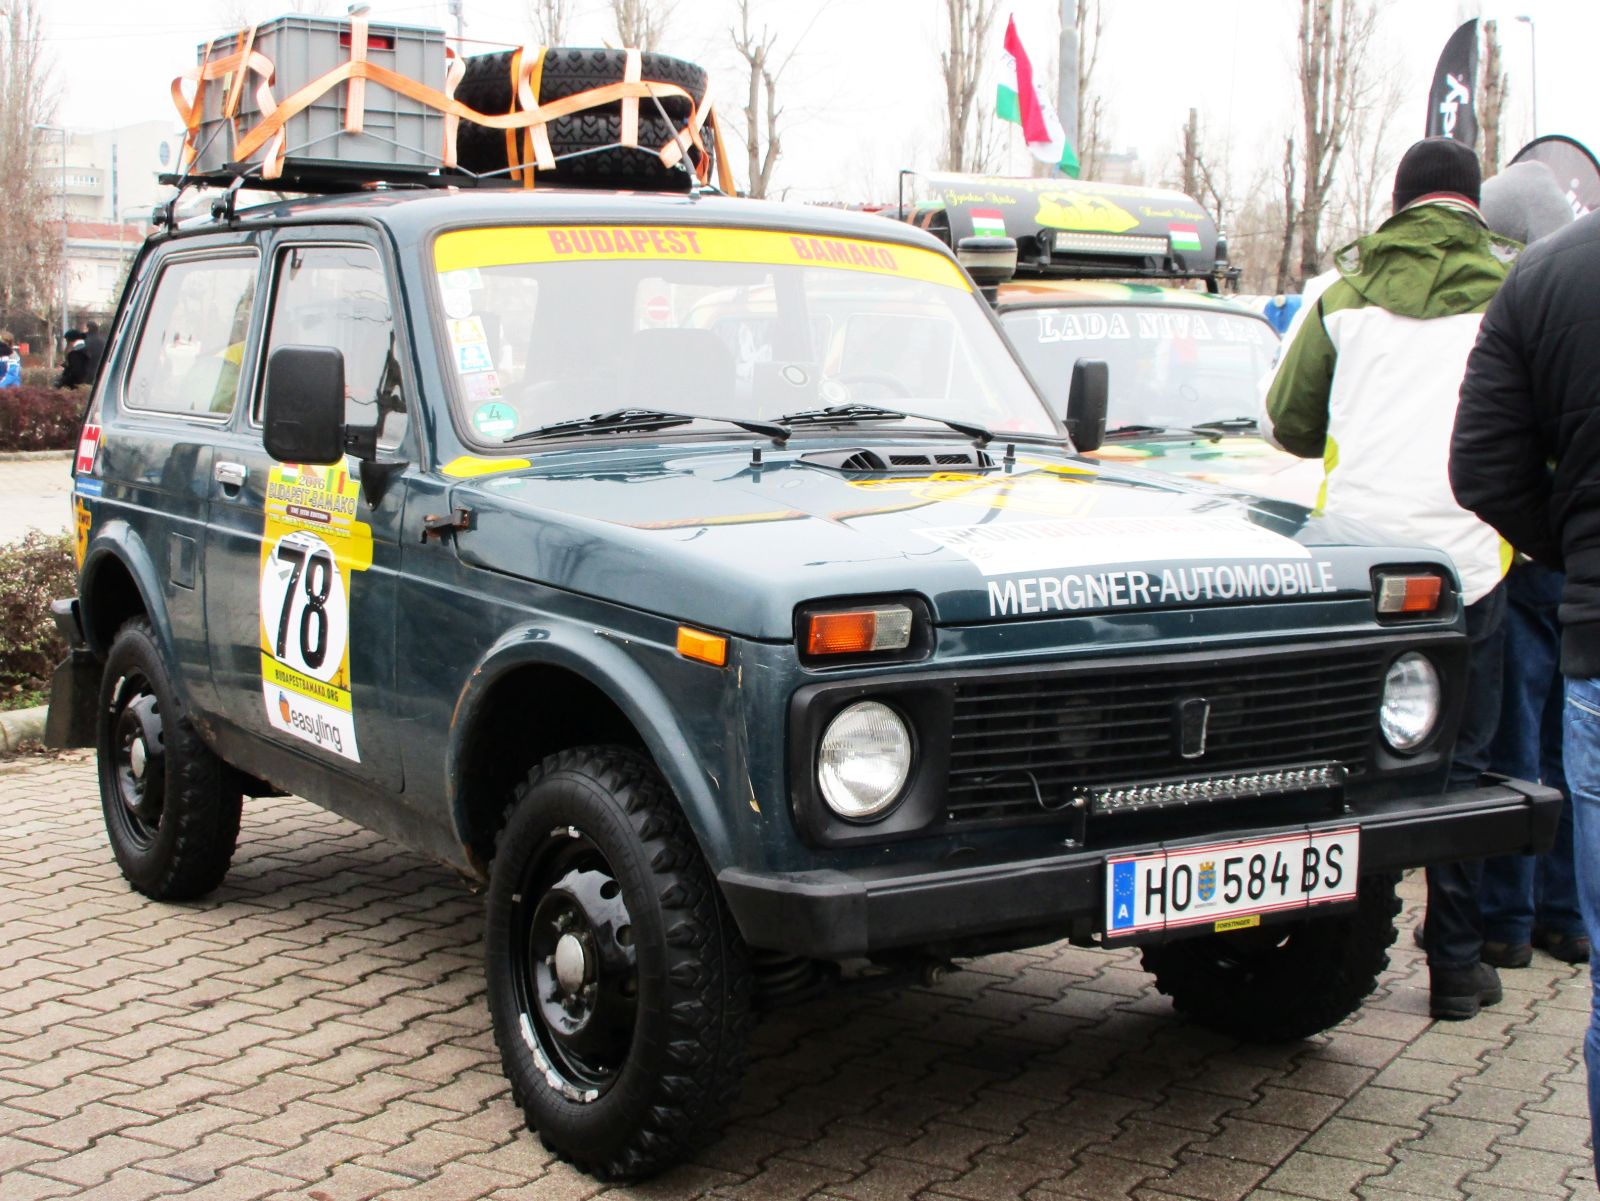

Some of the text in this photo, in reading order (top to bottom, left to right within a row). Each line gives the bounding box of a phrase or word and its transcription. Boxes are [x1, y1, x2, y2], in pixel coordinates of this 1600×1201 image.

[547, 229, 899, 270] BUDAPEST BAMAKO
[1037, 311, 1131, 343] LADA
[1136, 311, 1213, 341] NIVA
[299, 475, 325, 490] 2016
[275, 539, 333, 670] 78
[988, 561, 1338, 617] MERGNER-AUTOMOBILE
[275, 669, 340, 702] BUDAPESTBAMAKO.ORG
[291, 711, 343, 753] easyling
[1145, 843, 1345, 917] HO 584 BS
[1117, 903, 1129, 919] A
